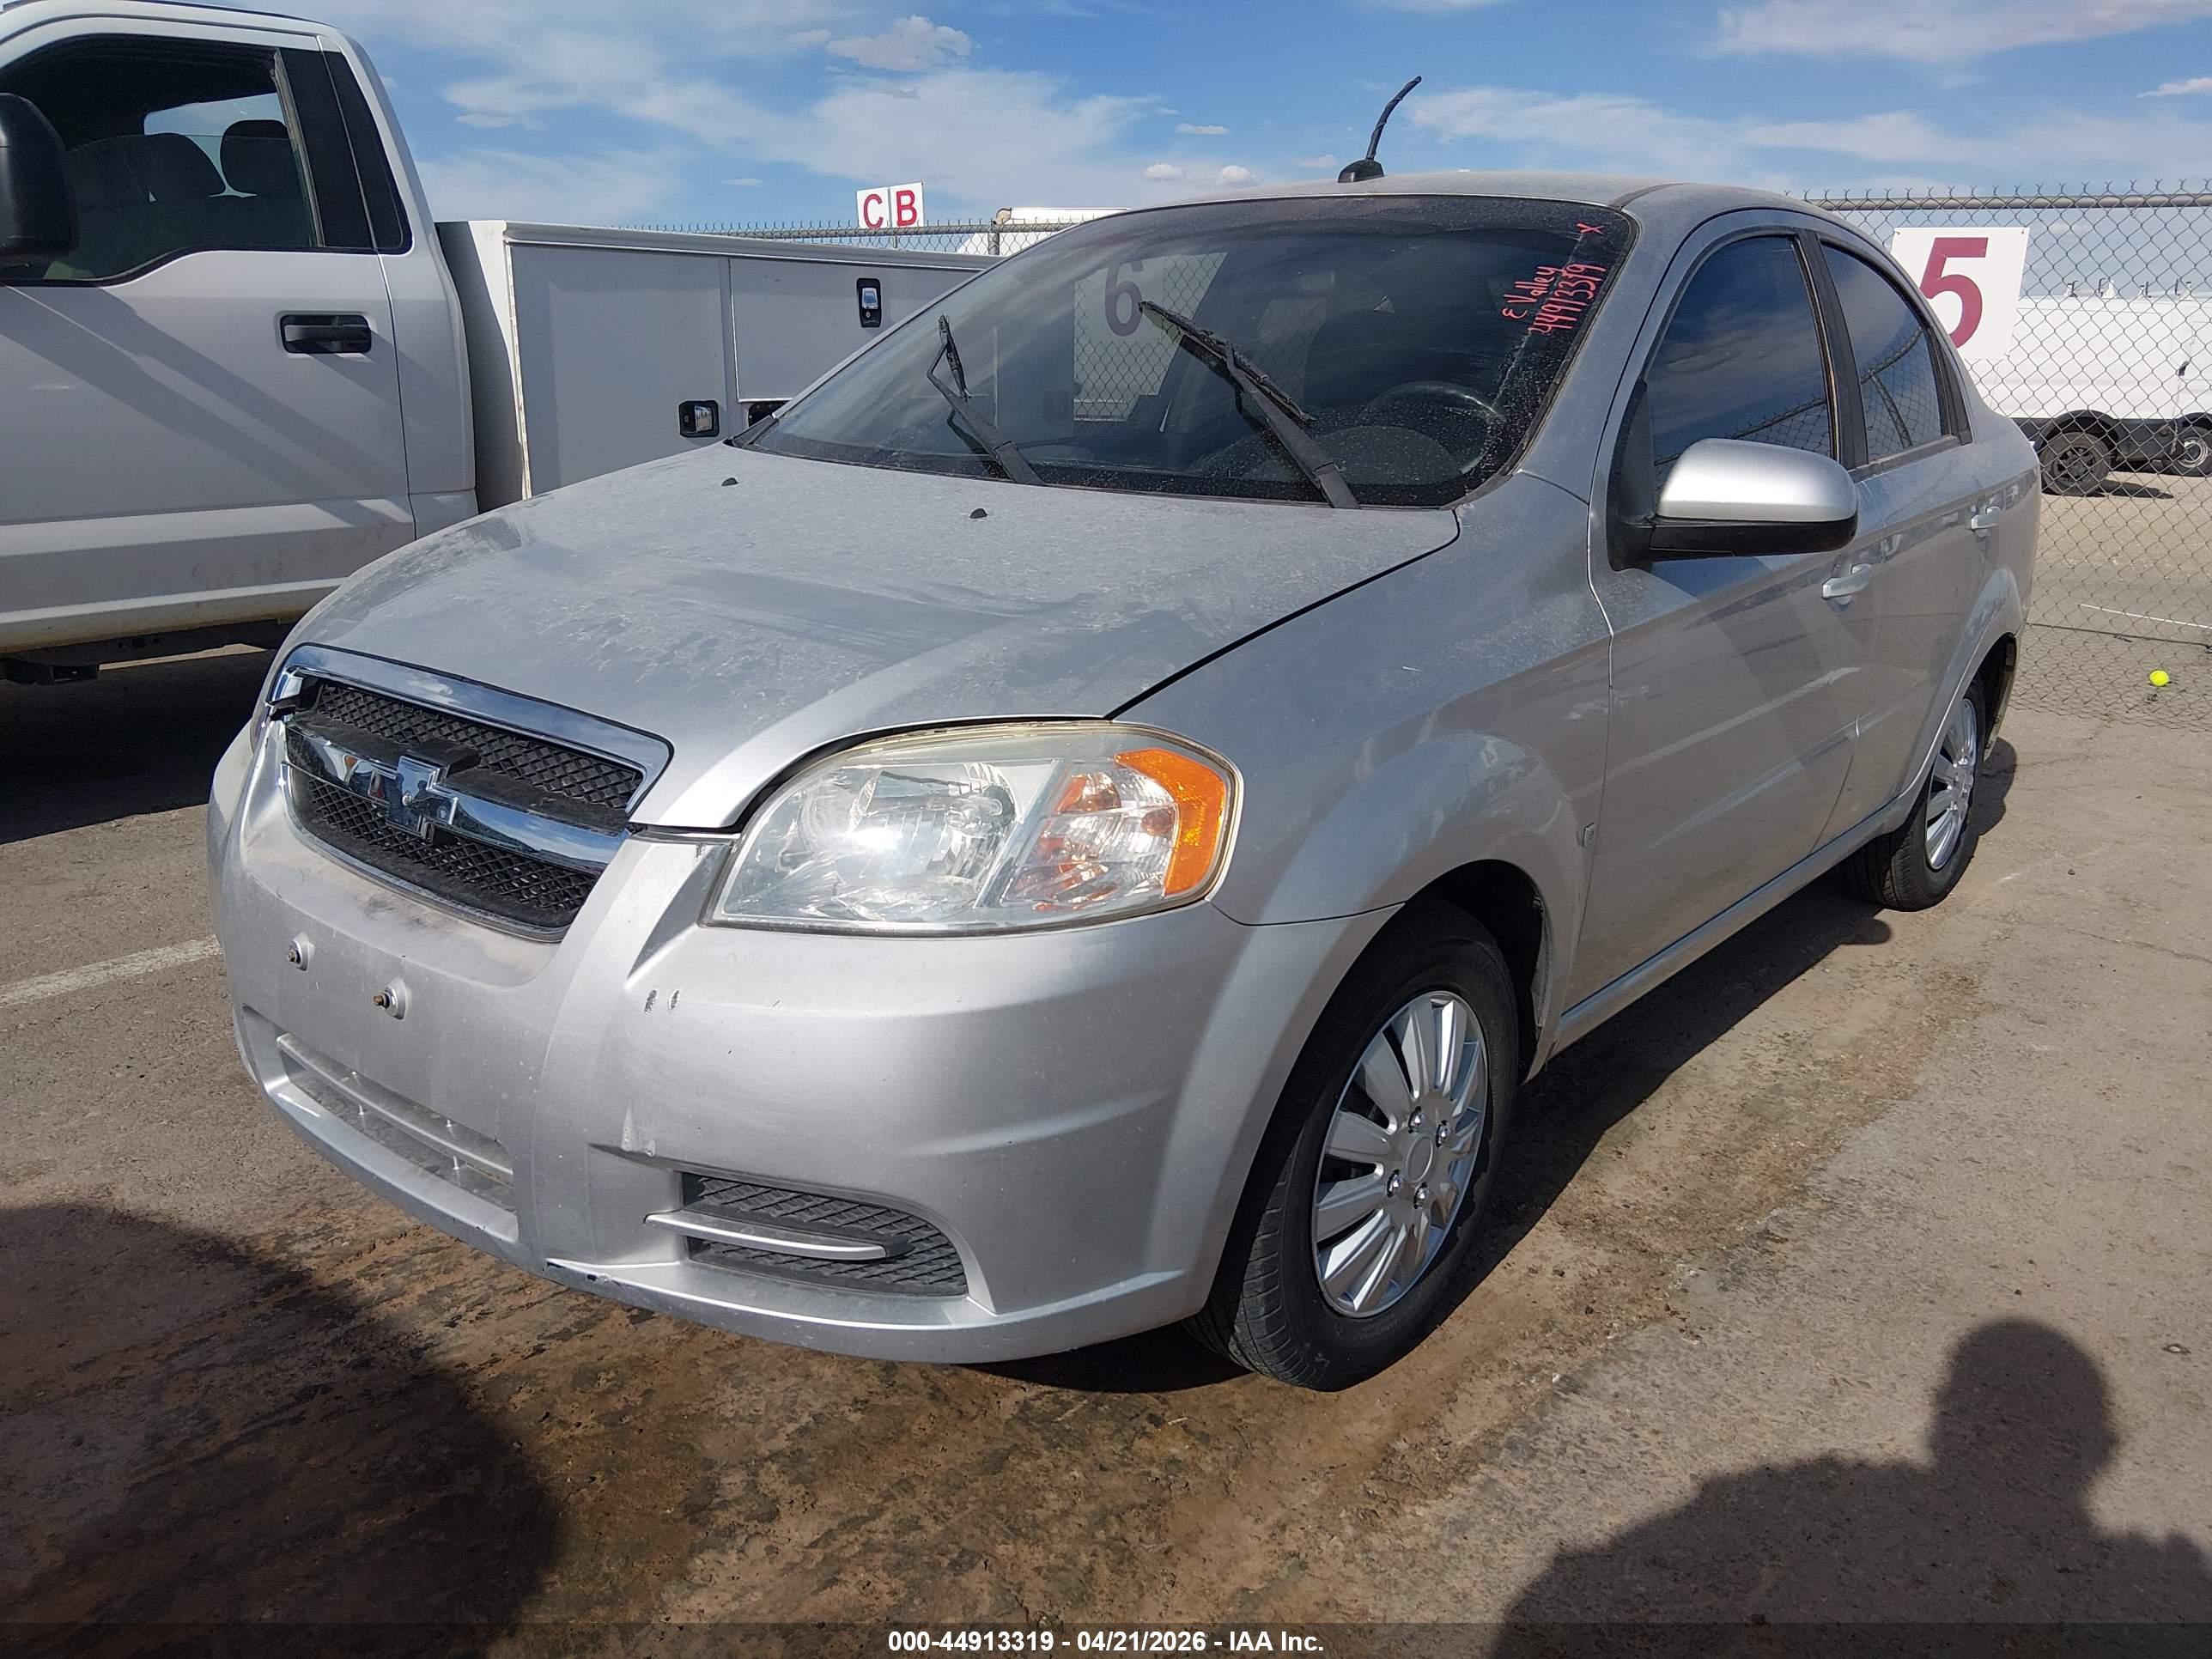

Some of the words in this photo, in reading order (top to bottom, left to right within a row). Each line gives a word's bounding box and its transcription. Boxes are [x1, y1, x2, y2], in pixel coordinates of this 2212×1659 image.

[1104, 260, 1144, 337] 6
[1503, 265, 1566, 303] Valley
[1528, 263, 1607, 333] 44913319
[1919, 237, 1989, 349] 5
